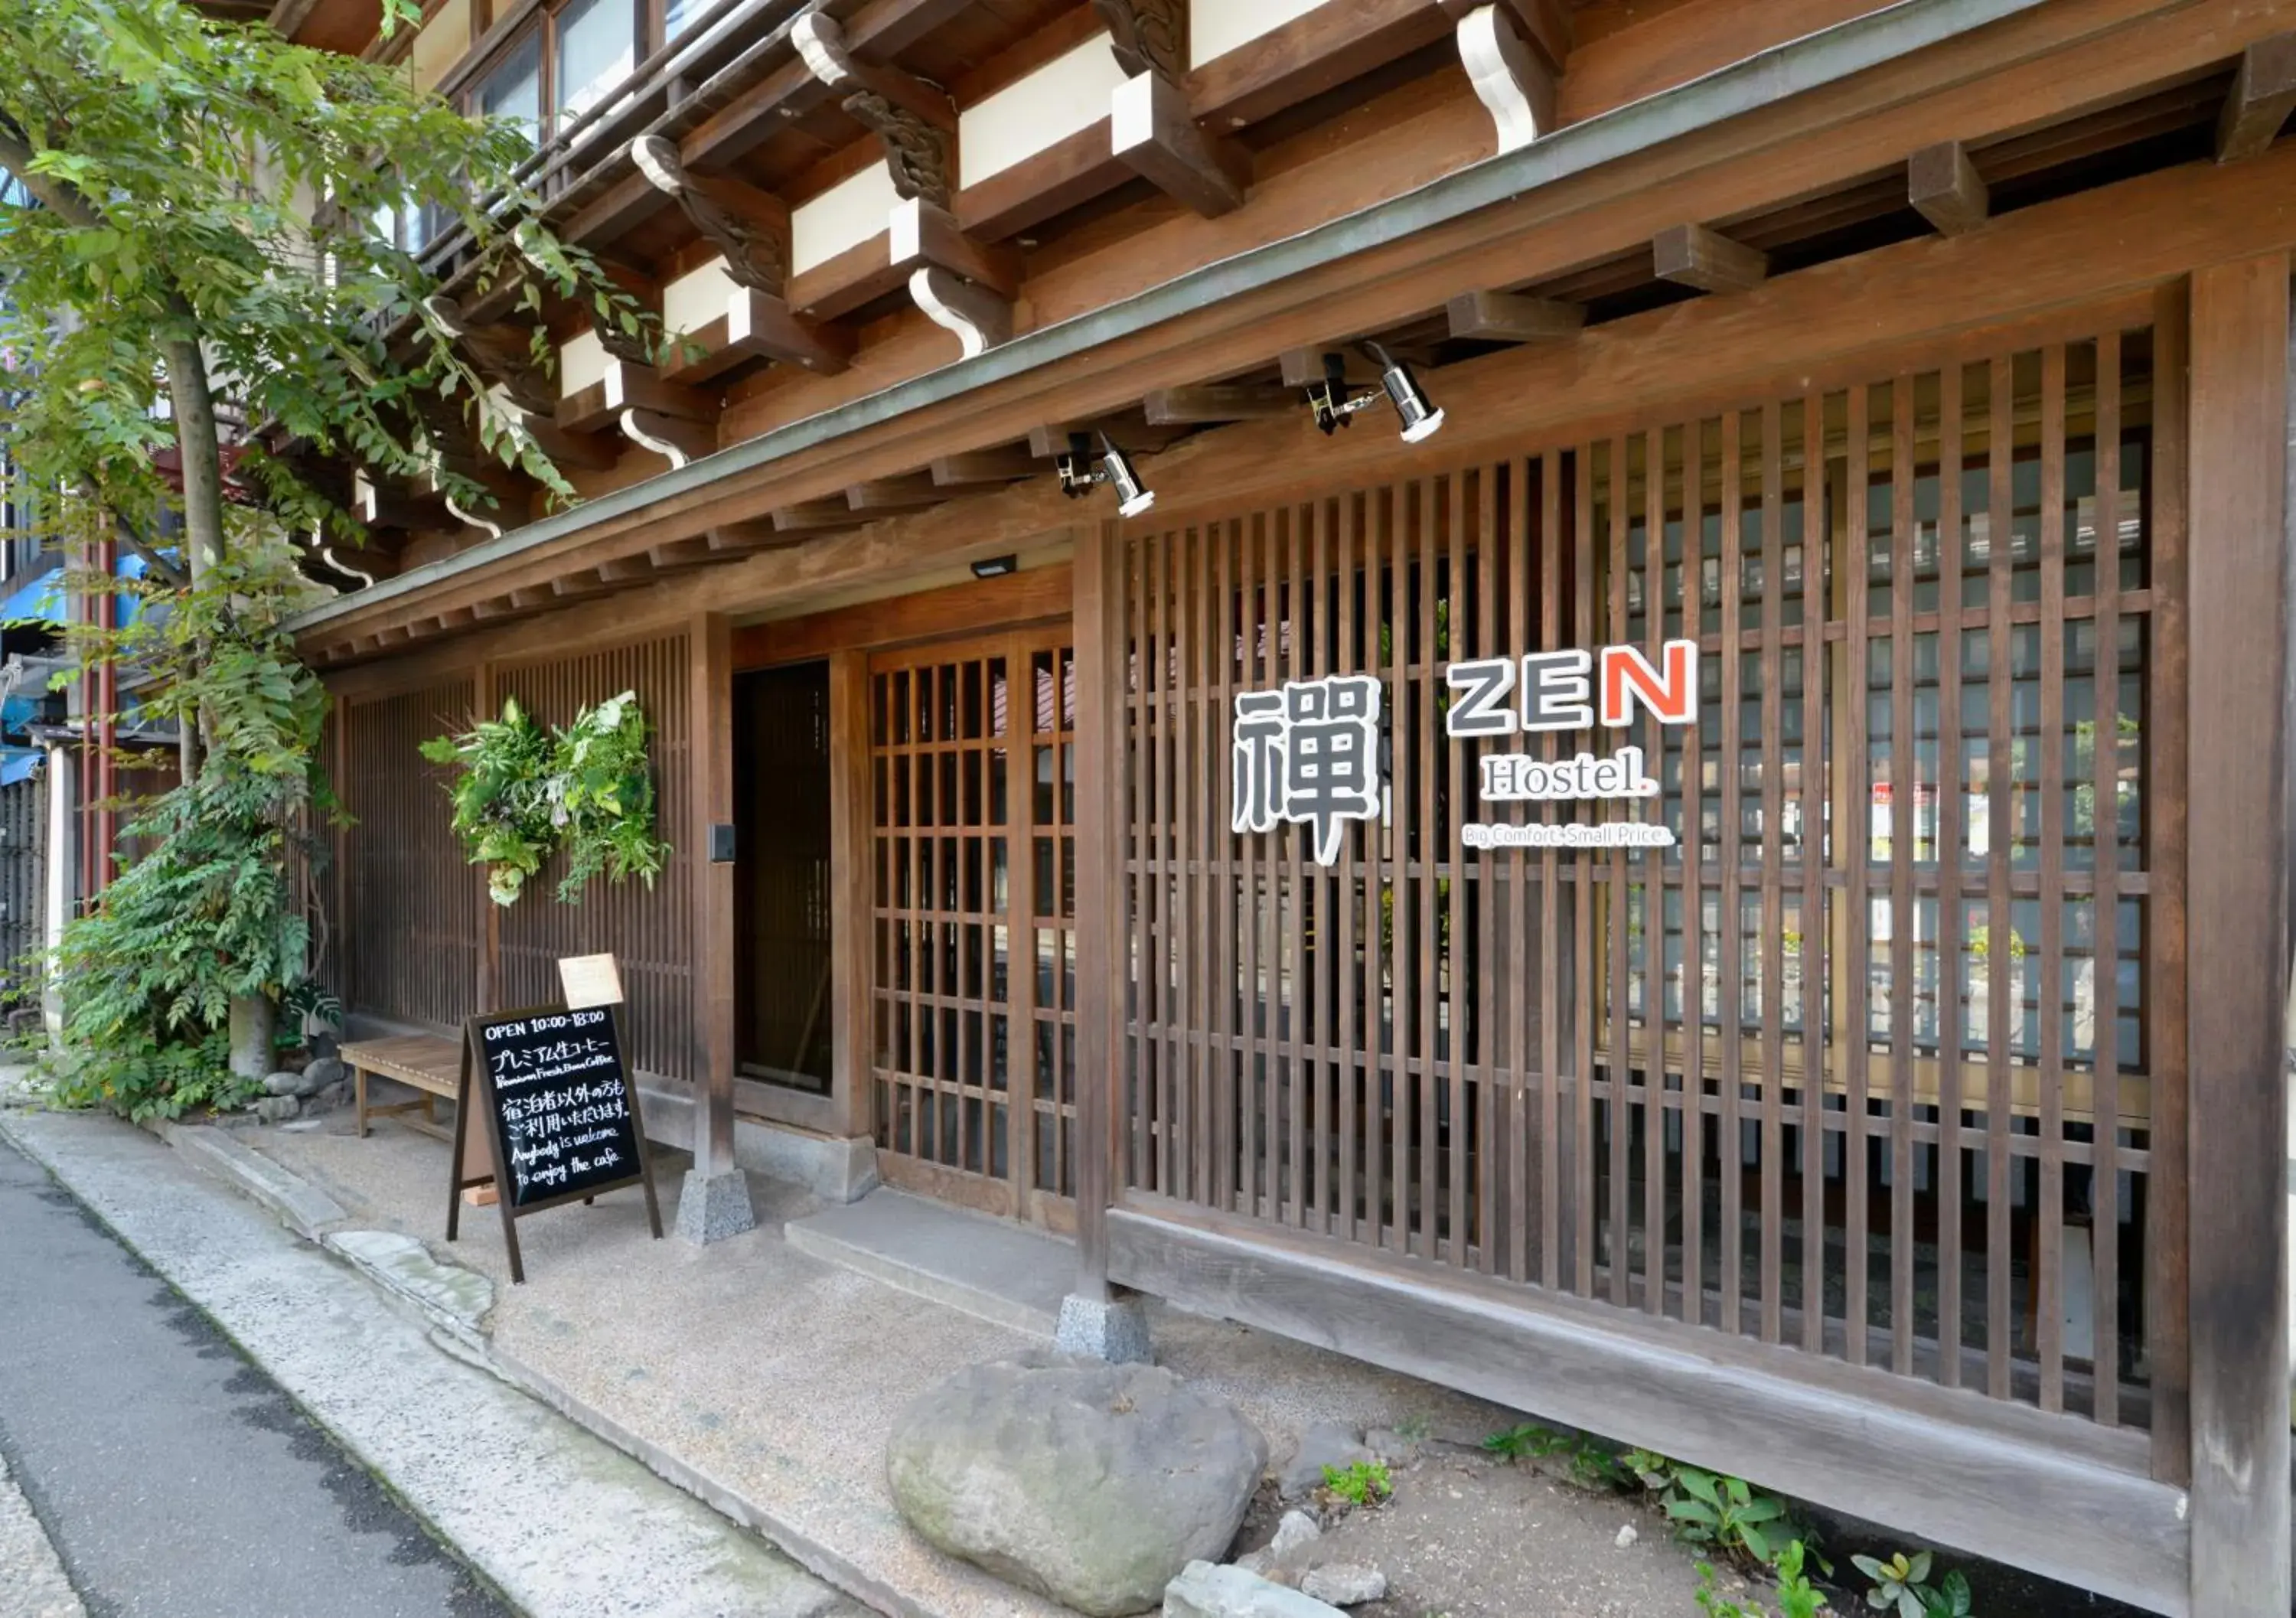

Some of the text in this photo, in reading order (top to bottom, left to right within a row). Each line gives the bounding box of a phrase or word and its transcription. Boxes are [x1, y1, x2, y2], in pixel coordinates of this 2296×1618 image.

[1449, 644, 1688, 732] ZEN
[1234, 678, 1374, 863] 禪
[1465, 827, 1489, 846] Big
[1567, 826, 1611, 843] Small
[485, 1010, 605, 1040] OPEN 10:00-18:00
[491, 1038, 610, 1072] プレミアム生コーヒー
[536, 1065, 563, 1079] Fresh
[502, 1078, 625, 1121] 宿泊者以外の方も
[511, 1127, 619, 1166] Anybody is welcome
[516, 1172, 530, 1186] to
[532, 1163, 567, 1186] enjoy
[570, 1156, 591, 1174] the
